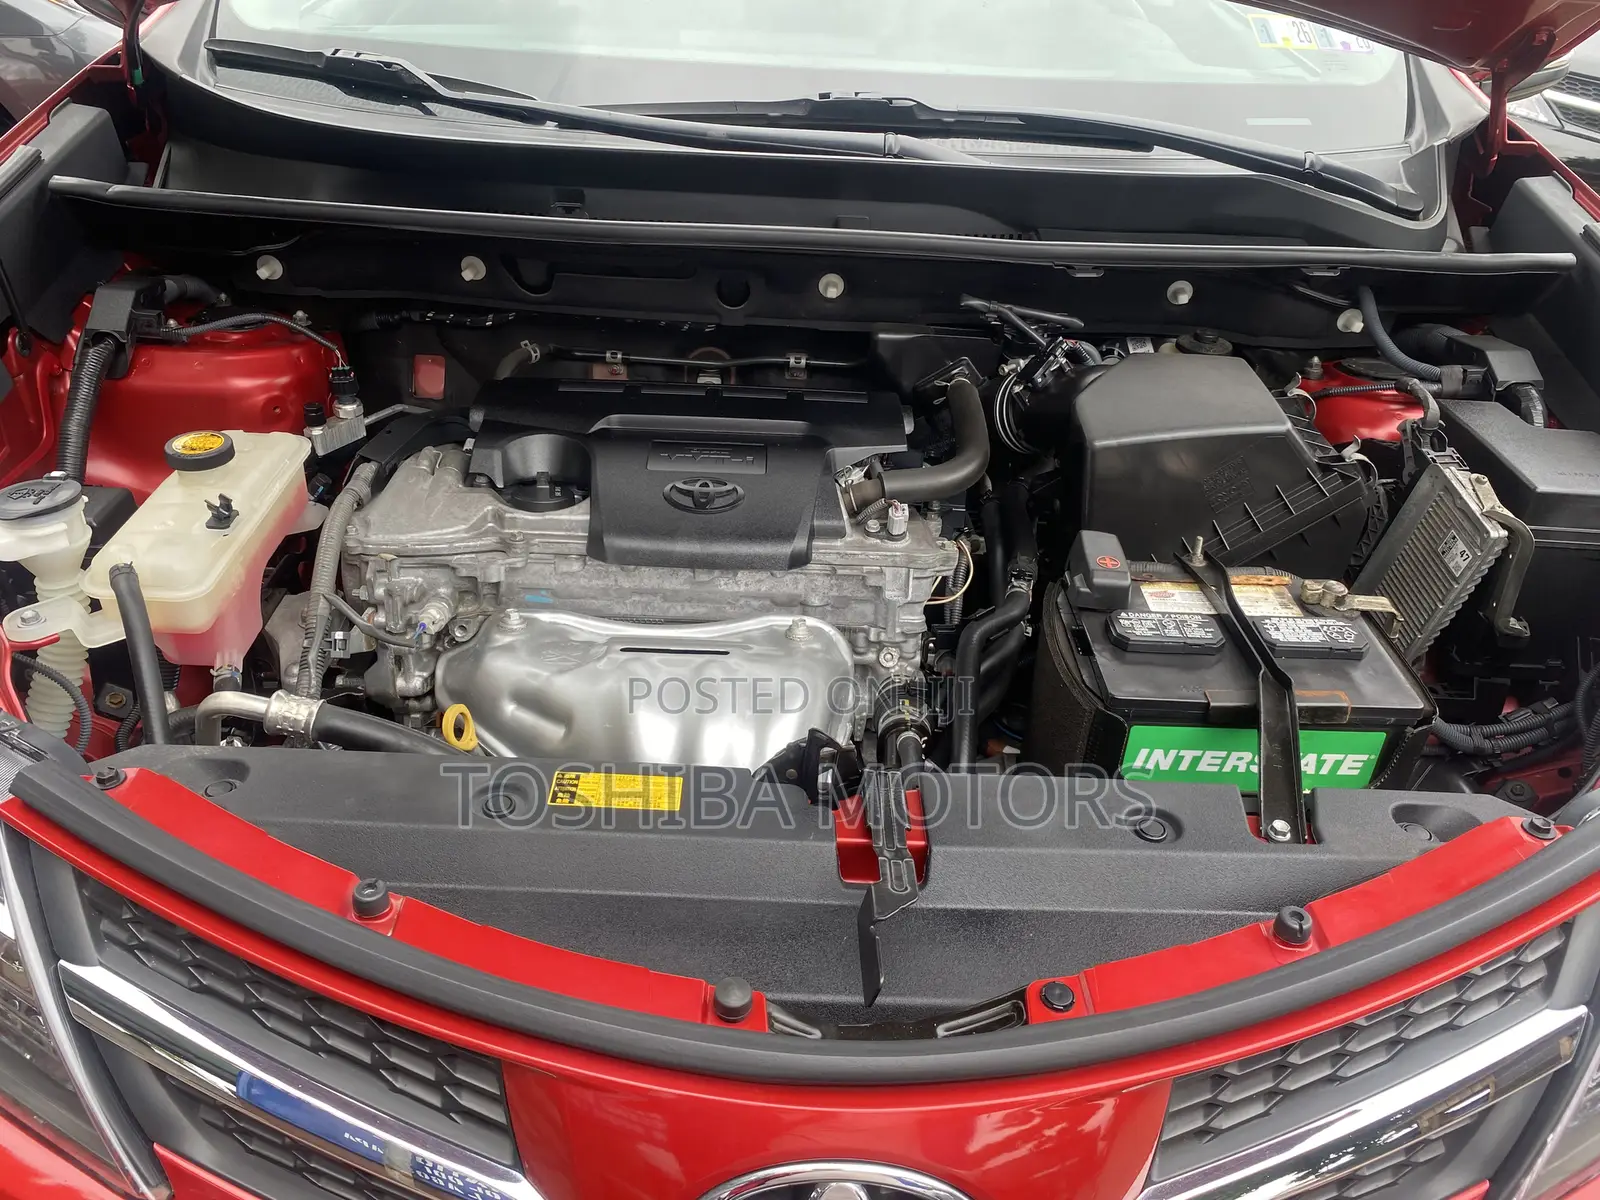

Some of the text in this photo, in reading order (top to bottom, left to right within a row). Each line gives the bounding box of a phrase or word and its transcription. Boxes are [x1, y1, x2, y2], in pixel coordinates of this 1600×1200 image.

[1292, 20, 1312, 43] 26
[1459, 549, 1470, 562] 47
[1127, 612, 1162, 620] DANGER
[1132, 748, 1370, 775] INTERATE
